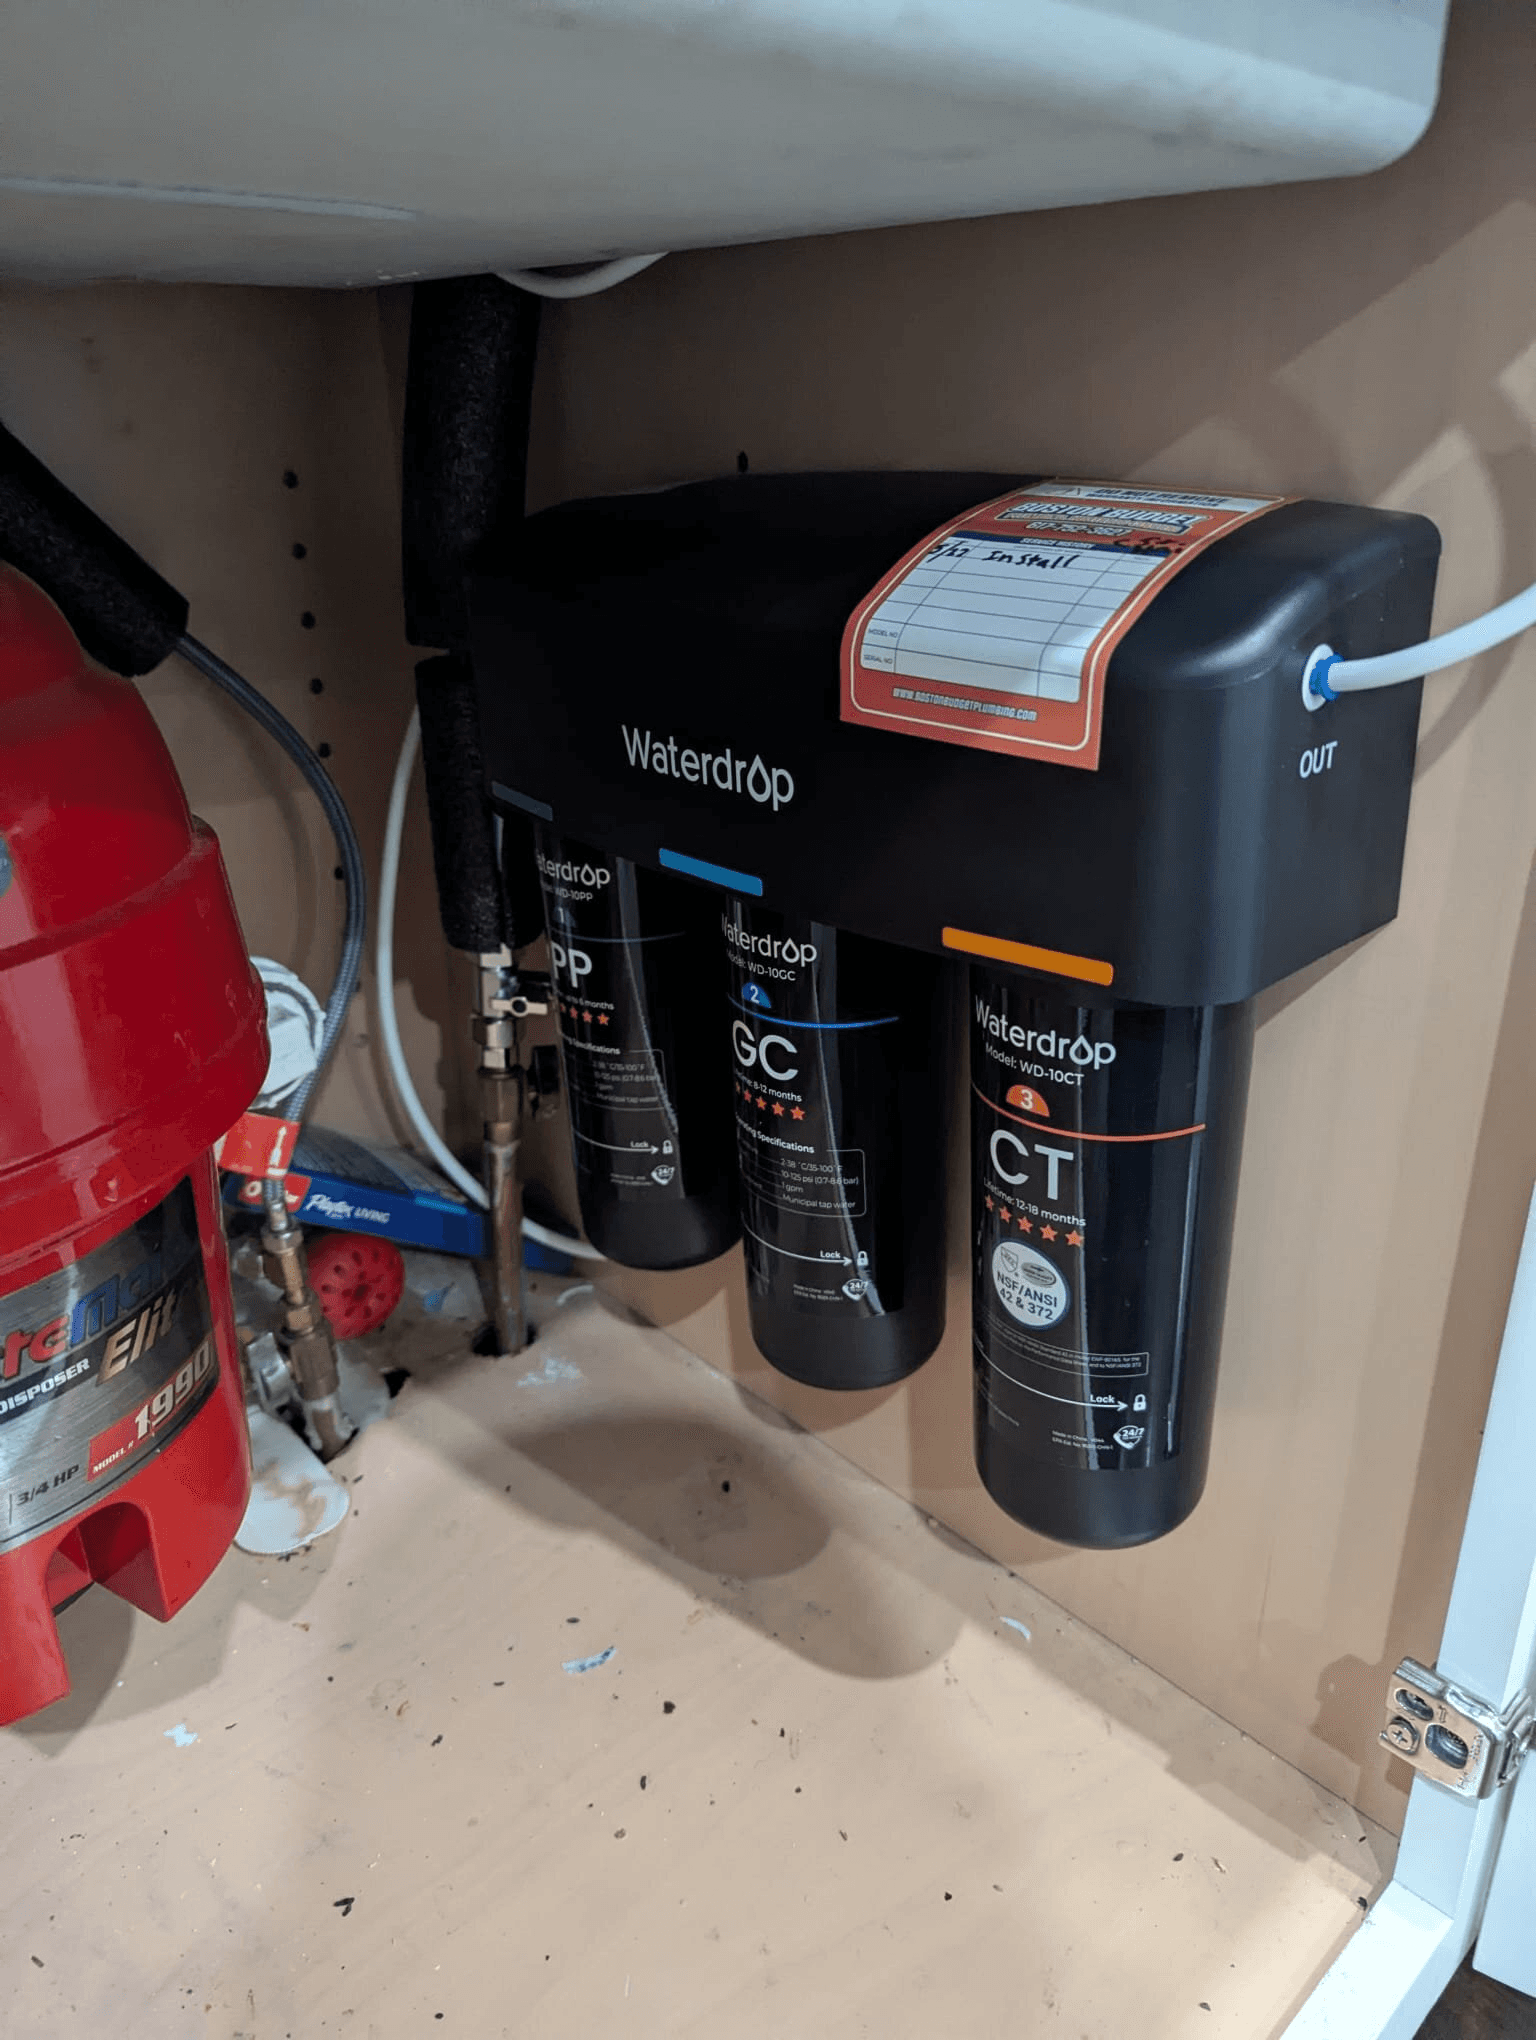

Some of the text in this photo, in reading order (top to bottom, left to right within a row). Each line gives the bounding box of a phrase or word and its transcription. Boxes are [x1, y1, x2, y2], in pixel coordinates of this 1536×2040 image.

[1012, 502, 1110, 517] BOSTON
[621, 724, 795, 812] Waterdrop
[1299, 740, 1338, 779] OUT
[550, 940, 593, 989] PP
[747, 961, 797, 982] WD-10GC
[750, 984, 760, 1004] 2
[975, 994, 1117, 1071] Waterdrop
[732, 1019, 799, 1082] GC
[985, 1042, 1085, 1087] Model: WD-10CT
[768, 1088, 803, 1103] months
[1020, 1088, 1034, 1111] 3
[989, 1128, 1075, 1202] CT
[785, 1184, 804, 1193] gpm
[819, 1201, 832, 1209] tap
[1016, 1198, 1039, 1216] 12-18
[1040, 1209, 1087, 1227] months
[820, 1250, 841, 1259] Lock
[997, 1269, 1058, 1308] NSF/ANSI
[1000, 1287, 1054, 1321] 42 & 372
[98, 1287, 180, 1385] Elit
[93, 1447, 125, 1474] MODEL
[134, 1340, 211, 1441] 1990
[1089, 1394, 1116, 1404] Lock
[1122, 1427, 1145, 1437] 24/7
[17, 1464, 80, 1507] 3/4 HP
